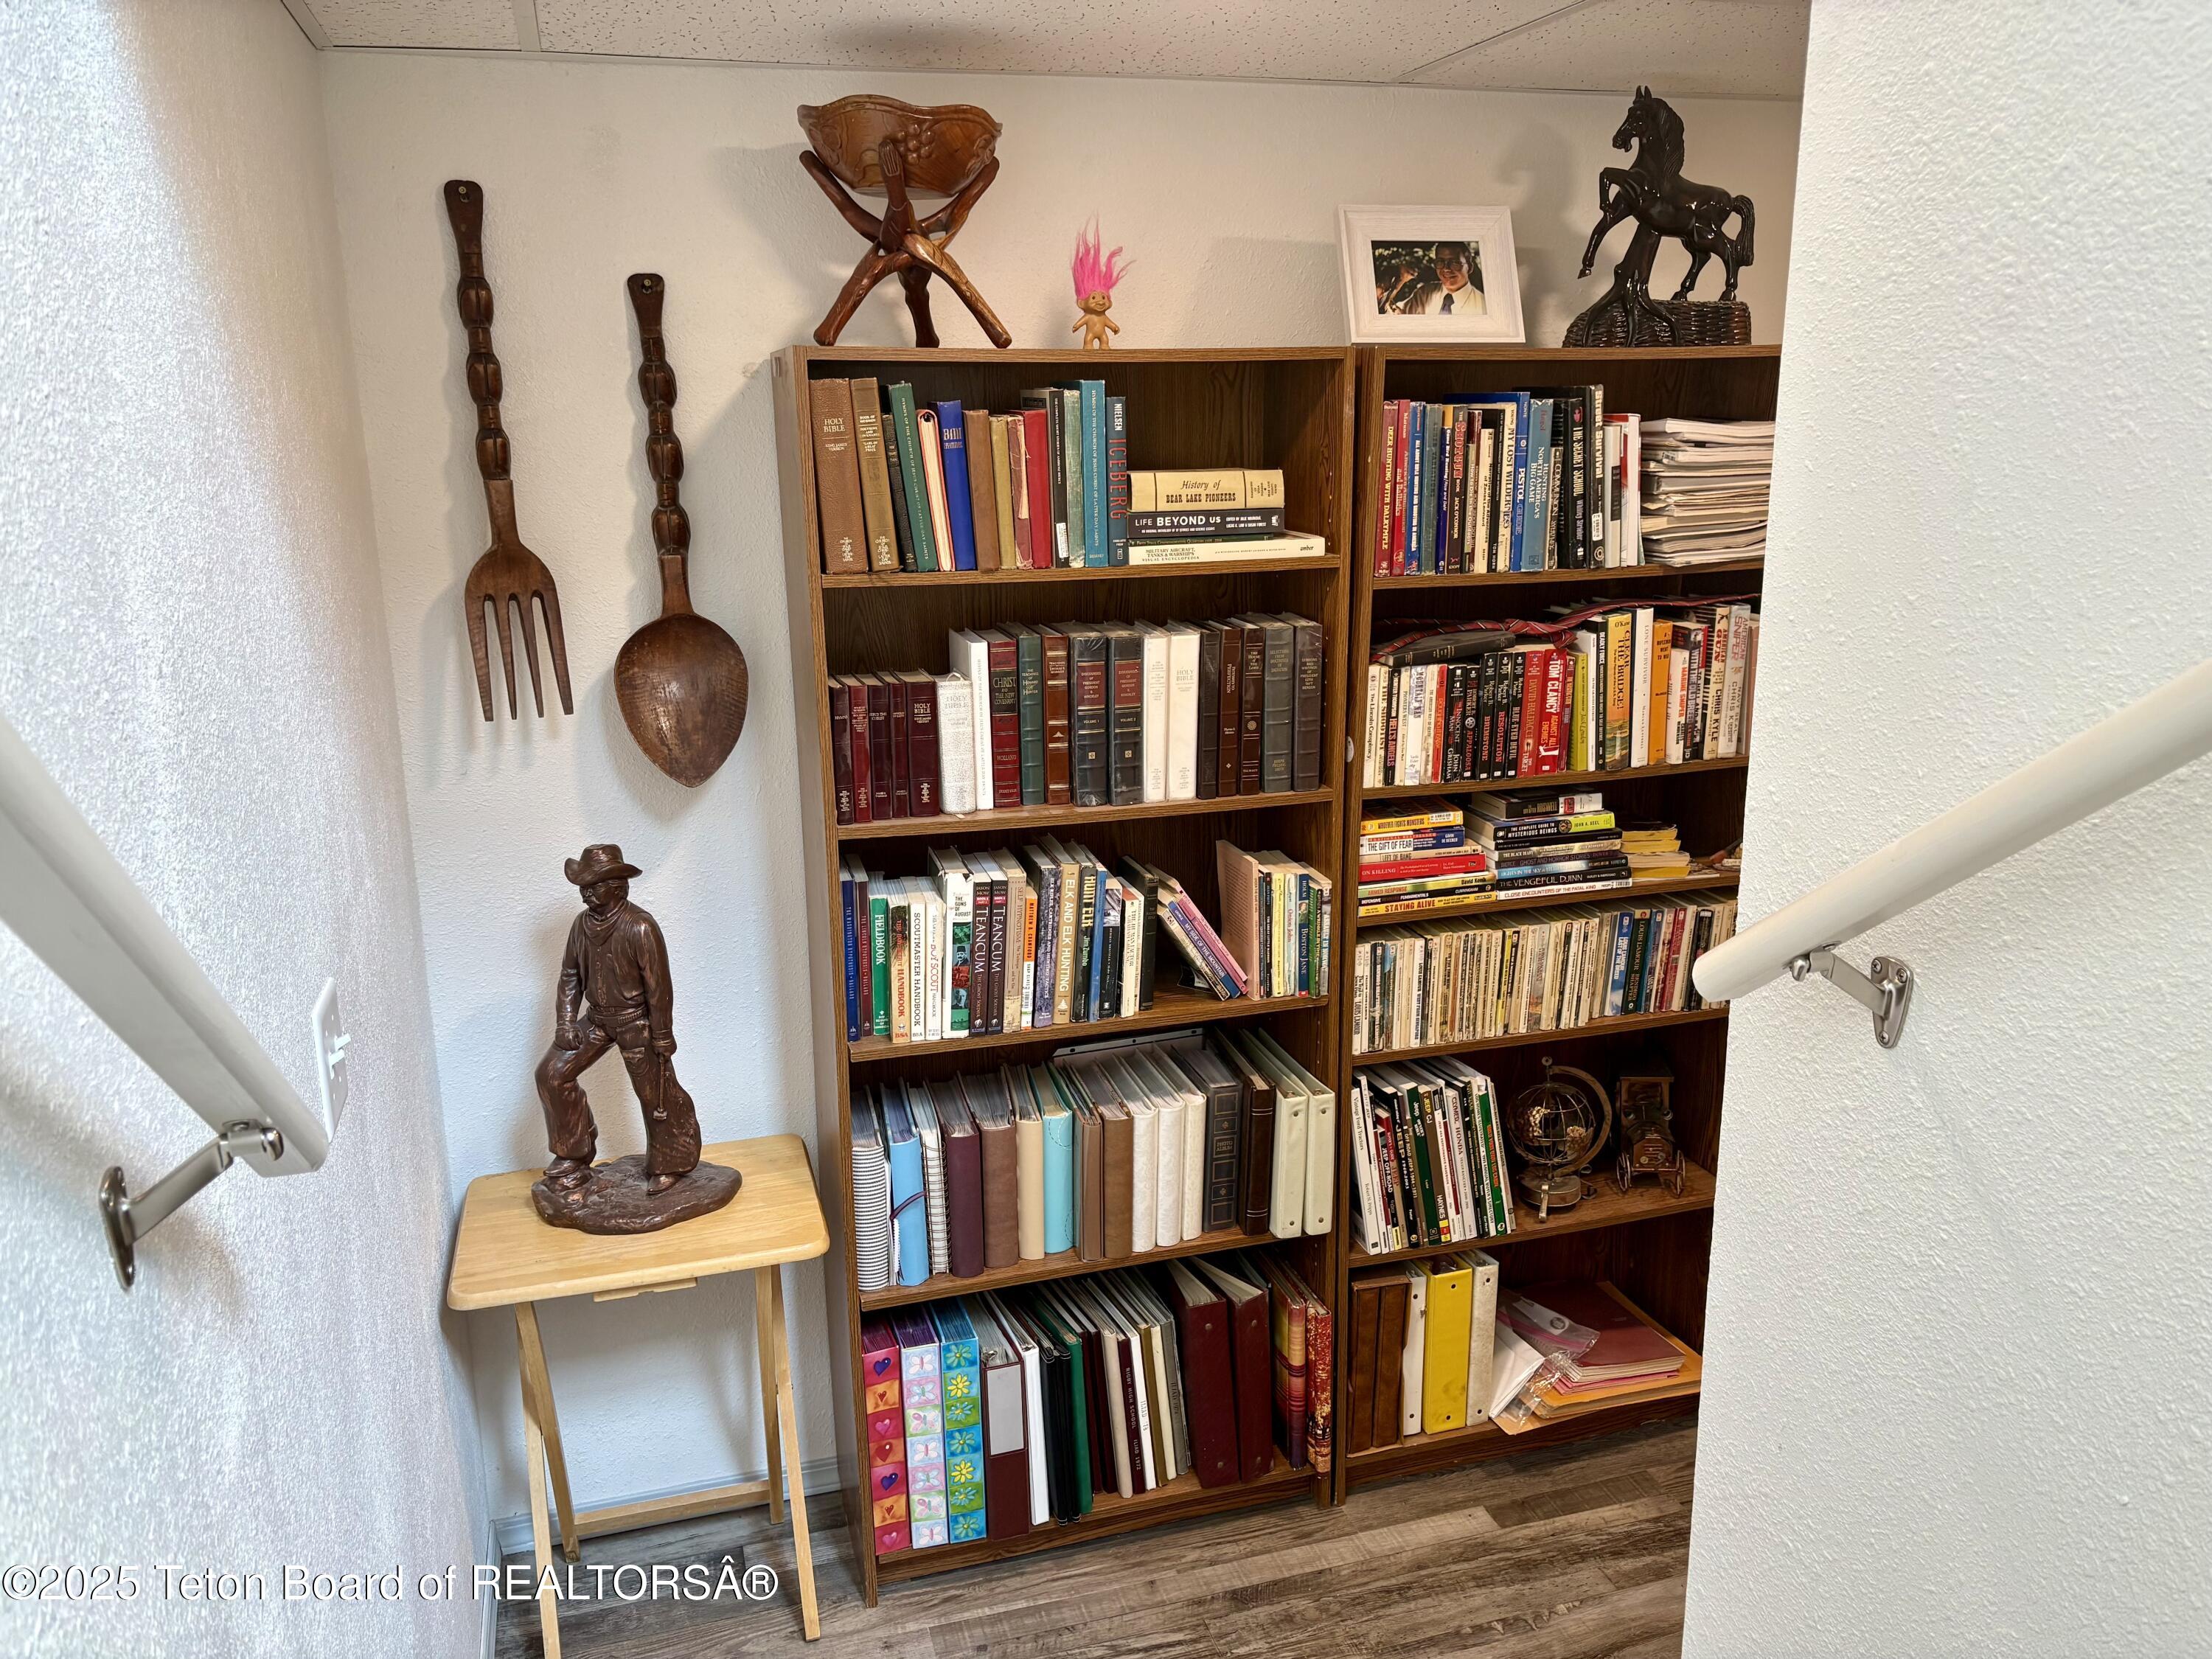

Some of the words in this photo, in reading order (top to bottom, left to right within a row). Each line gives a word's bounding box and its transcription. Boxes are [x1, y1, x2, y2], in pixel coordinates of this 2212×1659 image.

[824, 417, 844, 426] HOLY
[1114, 403, 1123, 431] NIELSEN
[1594, 390, 1603, 428] Street
[823, 424, 846, 434] BIBLE
[1573, 426, 1583, 441] THE
[1453, 421, 1467, 479] SHOTGUN
[1537, 446, 1545, 478] NORTH
[1573, 442, 1584, 468] SECRET
[1595, 431, 1603, 479] Survival
[1385, 448, 1393, 481] HUNTING
[1108, 438, 1128, 520] ICEBERG
[1181, 480, 1209, 490] History
[1213, 479, 1222, 490] of
[1517, 467, 1526, 503] PISTOL
[1541, 463, 1549, 501] HUNTING
[1551, 463, 1562, 516] COMMUNION
[1573, 470, 1584, 497] SCHOOL
[1166, 494, 1183, 504] BEAR
[1186, 493, 1203, 503] LAKE
[1206, 493, 1237, 502] PIONEERS
[1383, 482, 1391, 504] WITH
[1534, 479, 1543, 519] AMERICA'S
[1135, 518, 1152, 526] LIFE
[1156, 515, 1206, 526] BEYOND
[1382, 505, 1391, 550] DALRYMPLE
[1515, 504, 1524, 535] GUIDE
[1617, 638, 1625, 662] THE
[1714, 628, 1722, 664] GUN
[1731, 616, 1743, 661] SNIPER
[1739, 617, 1749, 661] AMERICAN
[1548, 659, 1561, 678] TOM
[1689, 649, 1700, 670] WITH
[993, 677, 1017, 688] CHRIST
[1616, 664, 1624, 710] BRIDGE!
[1679, 667, 1688, 693] MARINE
[1688, 669, 1698, 684] THE
[1528, 679, 1538, 701] DAVID
[1545, 681, 1558, 714] CLANCY
[1688, 685, 1697, 700] OLD
[1713, 689, 1722, 715] CHRIS
[1729, 681, 1738, 712] CHRIS
[1525, 703, 1537, 738] BALDACCI
[1550, 714, 1558, 736] AGAINST
[1686, 699, 1697, 726] BREED
[1388, 718, 1398, 740] HELL'S
[1481, 716, 1491, 761] BRIMSTONE
[1495, 711, 1505, 762] RESOLUTION
[1540, 721, 1549, 744] ENEMIES
[1711, 718, 1719, 742] KYLE
[1366, 726, 1374, 759] Conspiracy
[1386, 741, 1397, 767] ANGELS
[1445, 748, 1455, 779] GRISHAM
[1452, 754, 1460, 772] JOHN
[1507, 829, 1539, 838] MYSTERIOUS
[1540, 827, 1557, 835] BEINGS
[1368, 842, 1378, 852] THE
[1379, 841, 1390, 851] GIFT
[1391, 841, 1399, 849] OF
[1399, 840, 1412, 849] FEAR
[1064, 879, 1076, 899] ELK
[1062, 902, 1074, 923] AND
[1385, 901, 1414, 913] STAYING
[1416, 899, 1436, 909] ALIVE
[874, 914, 886, 965] FIELDBOOK
[975, 906, 989, 973] TEANCUM
[991, 905, 1006, 973] TEANCUM
[1062, 925, 1073, 945] ELK
[1082, 936, 1091, 947] Jim
[1636, 921, 1646, 940] LOUIS
[1082, 947, 1090, 967] Zumbo
[1184, 922, 1192, 931] MY
[1189, 930, 1198, 942] SIDE
[1201, 945, 1210, 957] THE
[1206, 953, 1225, 978] MOUNTAIN
[1619, 950, 1628, 971] L'AMOUR
[1633, 942, 1644, 971] L'AMOUR
[1060, 947, 1071, 992] HUNTING
[1300, 957, 1308, 975] JANE
[897, 969, 905, 1018] HANDBOOK
[1352, 1096, 1361, 1116] Vintage
[1413, 1102, 1421, 1117] Jeep
[1423, 1097, 1433, 1113] JEEP
[1354, 1116, 1363, 1129] Ford
[1425, 1114, 1433, 1124] CJ
[1357, 1130, 1366, 1151] Tractors
[1455, 1127, 1464, 1155] HONDA
[1380, 1147, 1390, 1161] JEEP
[1382, 1162, 1394, 1193] OFF-ROAD
[1436, 1194, 1446, 1220] HAYNES
